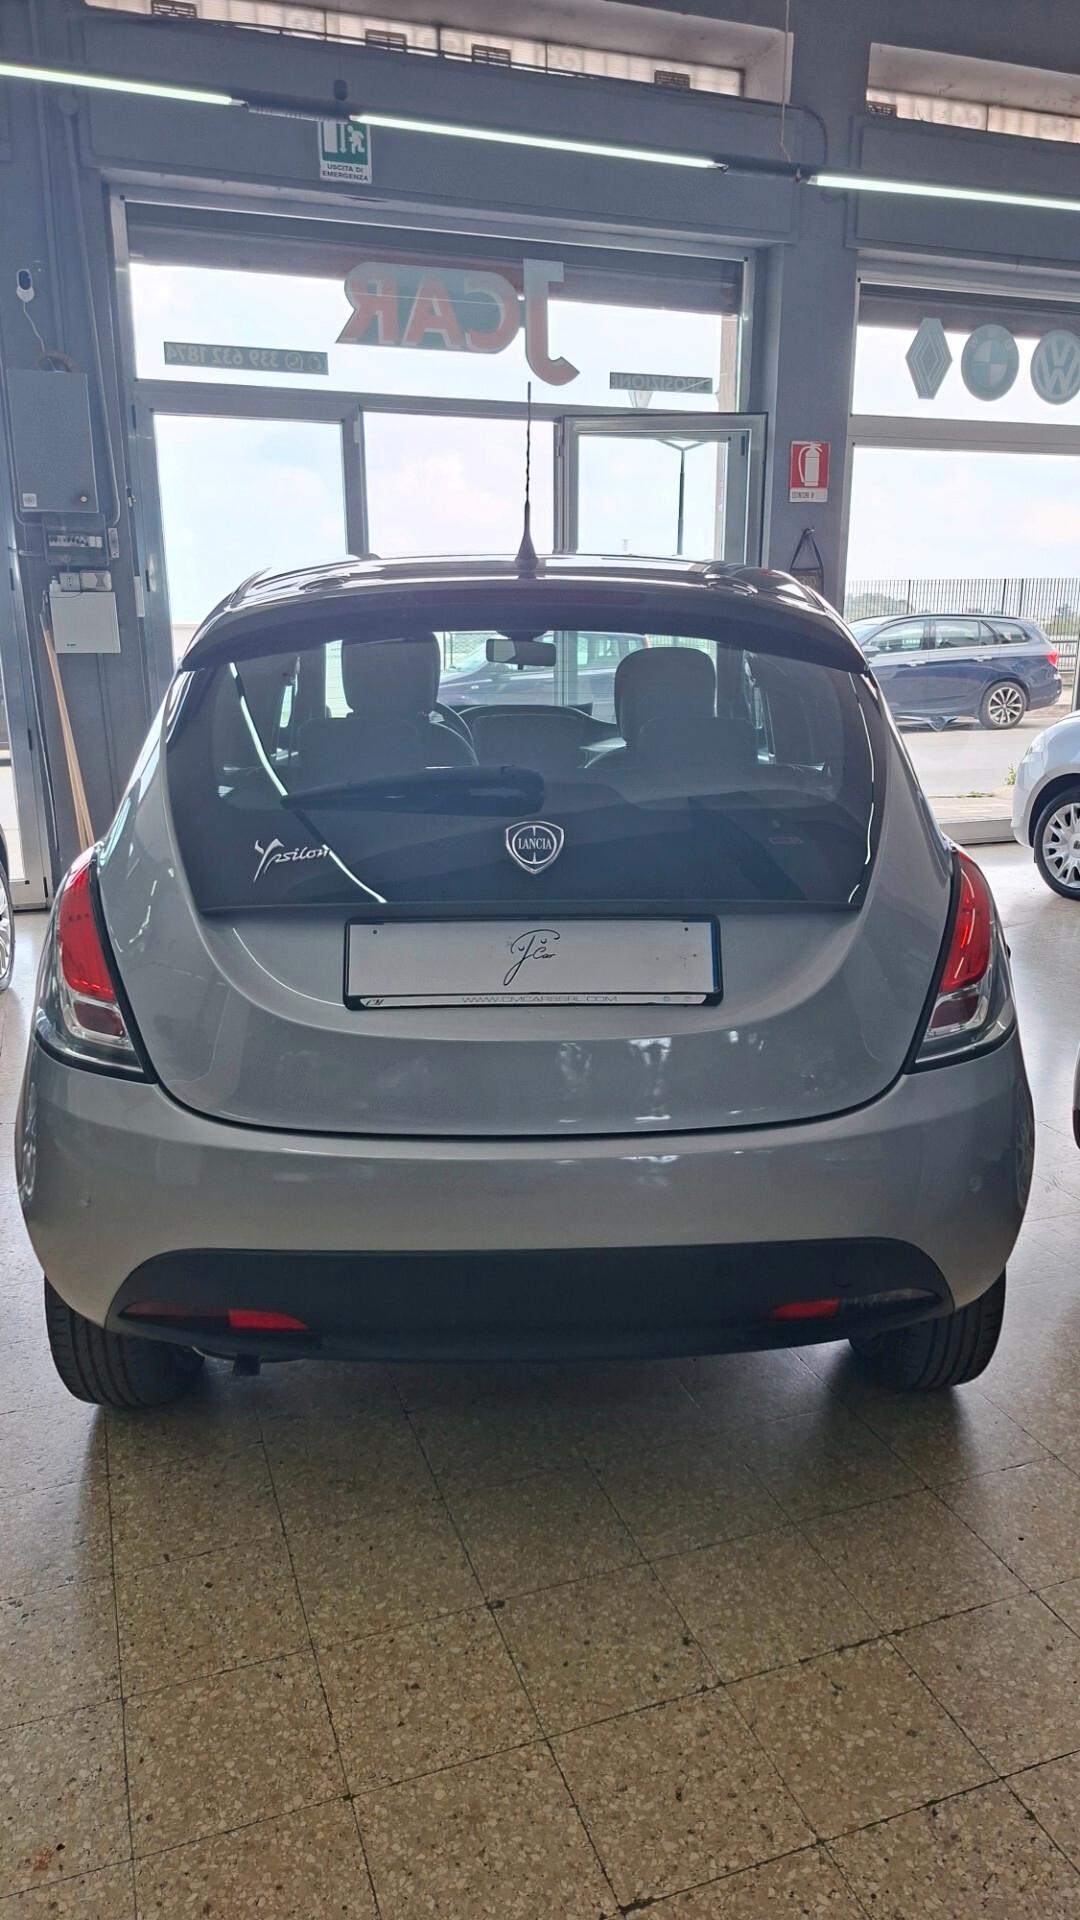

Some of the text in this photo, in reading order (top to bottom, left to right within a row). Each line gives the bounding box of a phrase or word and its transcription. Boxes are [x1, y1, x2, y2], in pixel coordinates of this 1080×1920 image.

[327, 163, 354, 173] USCITA
[322, 170, 369, 181] EMERGENZA
[518, 838, 552, 850] LANCIA
[253, 838, 329, 883] Ypsilon
